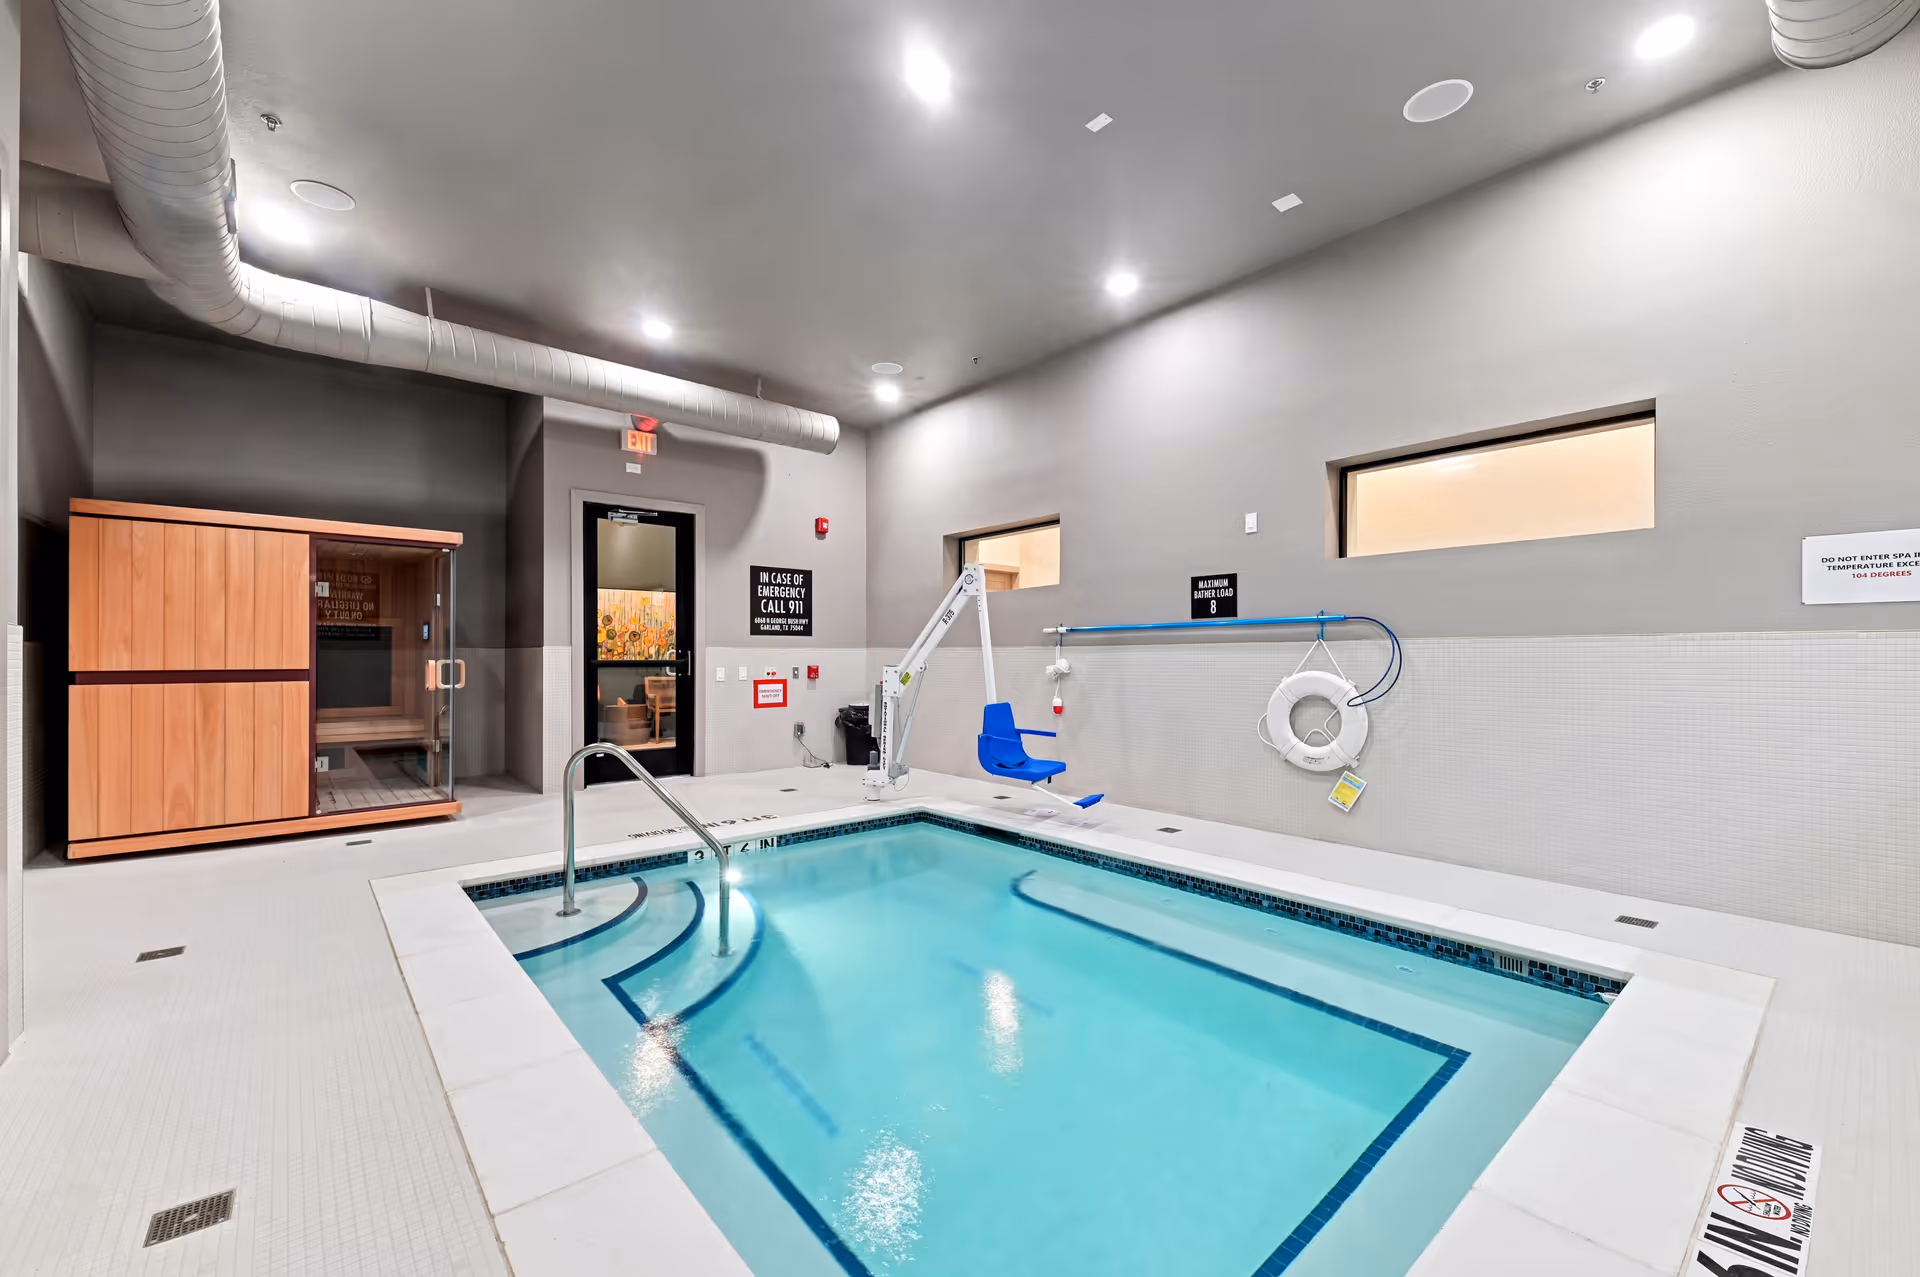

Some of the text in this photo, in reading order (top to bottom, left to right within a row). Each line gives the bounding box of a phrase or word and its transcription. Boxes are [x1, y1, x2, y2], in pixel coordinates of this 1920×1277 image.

[627, 429, 654, 453] EXIT
[1837, 555, 1858, 563] NOT
[1892, 552, 1911, 560] SPA
[1827, 562, 1894, 570] TEMPERATURE
[760, 571, 804, 586] IN CASE OF
[1870, 570, 1912, 578] DEGREES
[1199, 578, 1228, 589] MAXIMUM
[757, 585, 806, 599] EMERGENCY
[1194, 588, 1233, 599] BATHER LOAD
[760, 599, 803, 614] CALL 911
[1210, 600, 1216, 614] 8
[694, 849, 705, 861] 3
[760, 837, 775, 850] IN
[1736, 1127, 1814, 1183] DIVING
[1731, 1164, 1806, 1201] NO
[1790, 1202, 1813, 1238] NO DIVING
